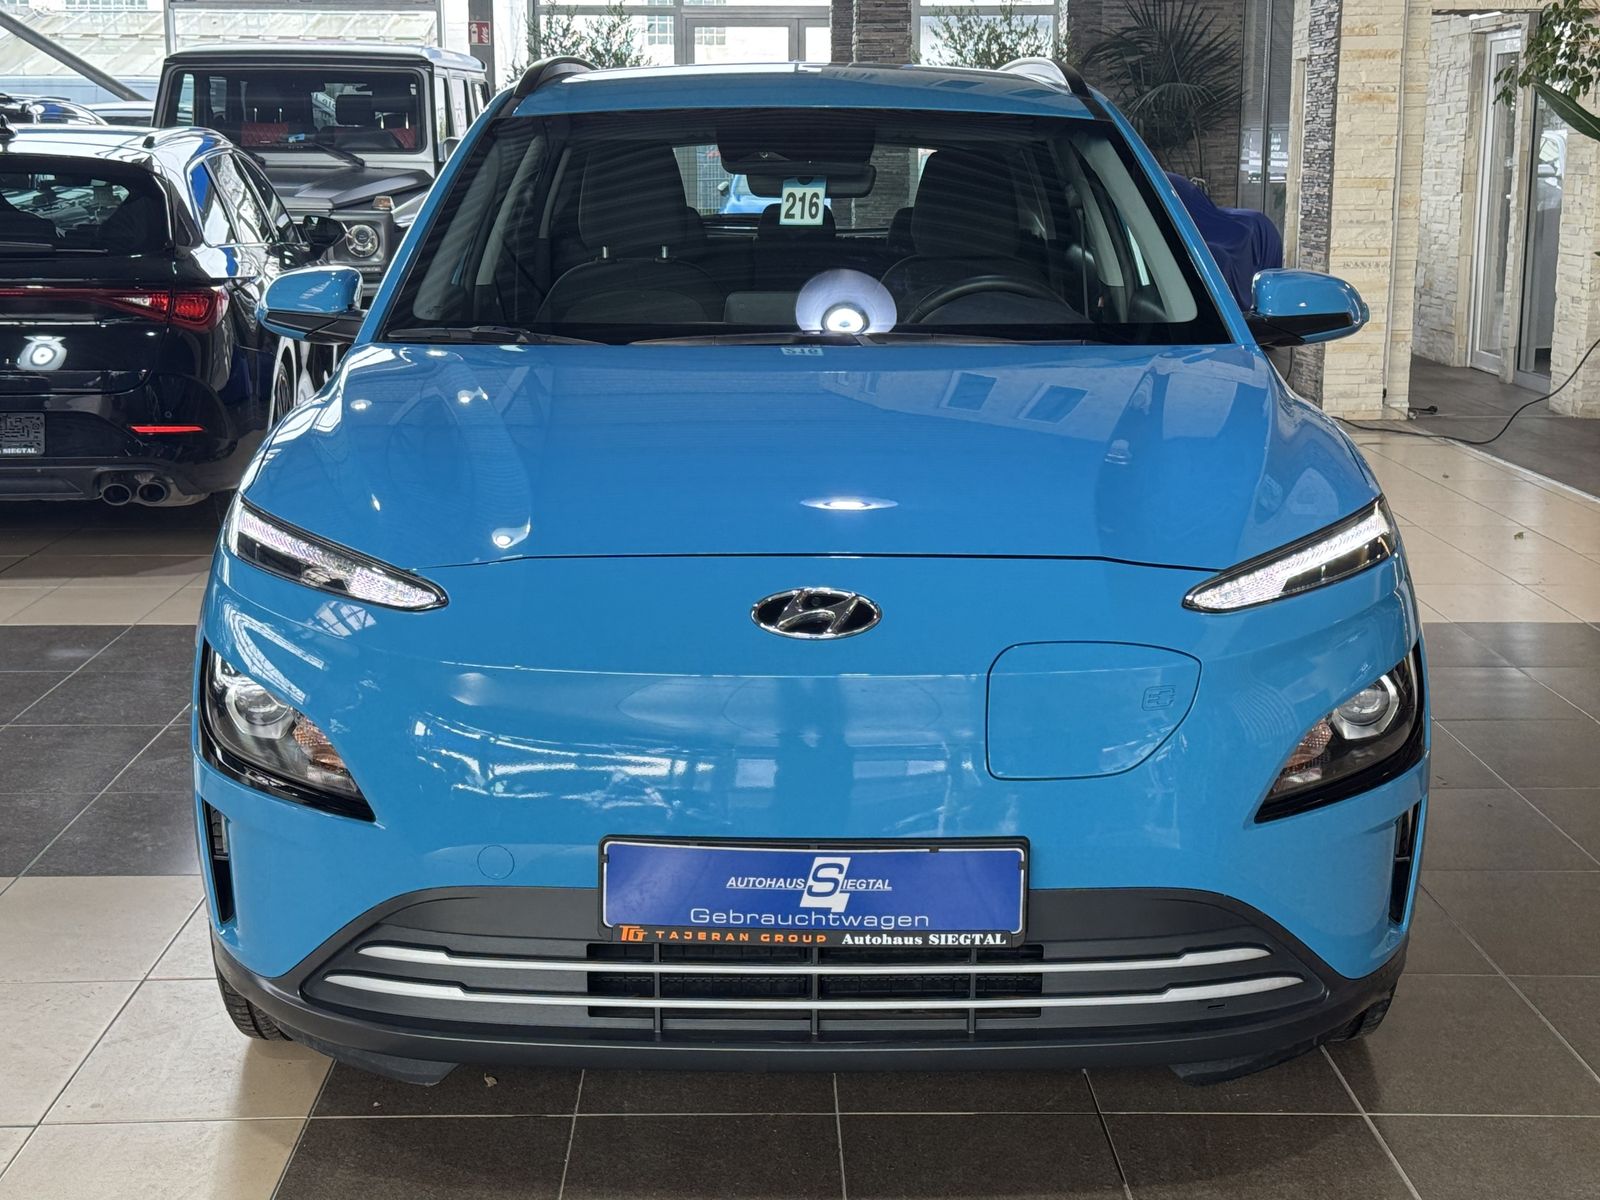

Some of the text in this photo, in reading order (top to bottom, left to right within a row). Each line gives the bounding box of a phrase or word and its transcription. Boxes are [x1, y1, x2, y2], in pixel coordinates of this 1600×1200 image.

[783, 191, 820, 220] 216
[726, 862, 893, 898] AUTOHAUS SIEGTAL
[690, 908, 929, 930] Gebrauchtwagen
[656, 930, 749, 942] TAJERAN
[760, 933, 827, 944] GROUP
[841, 933, 923, 945] Autohaus
[928, 932, 1007, 946] SIEGTAL
